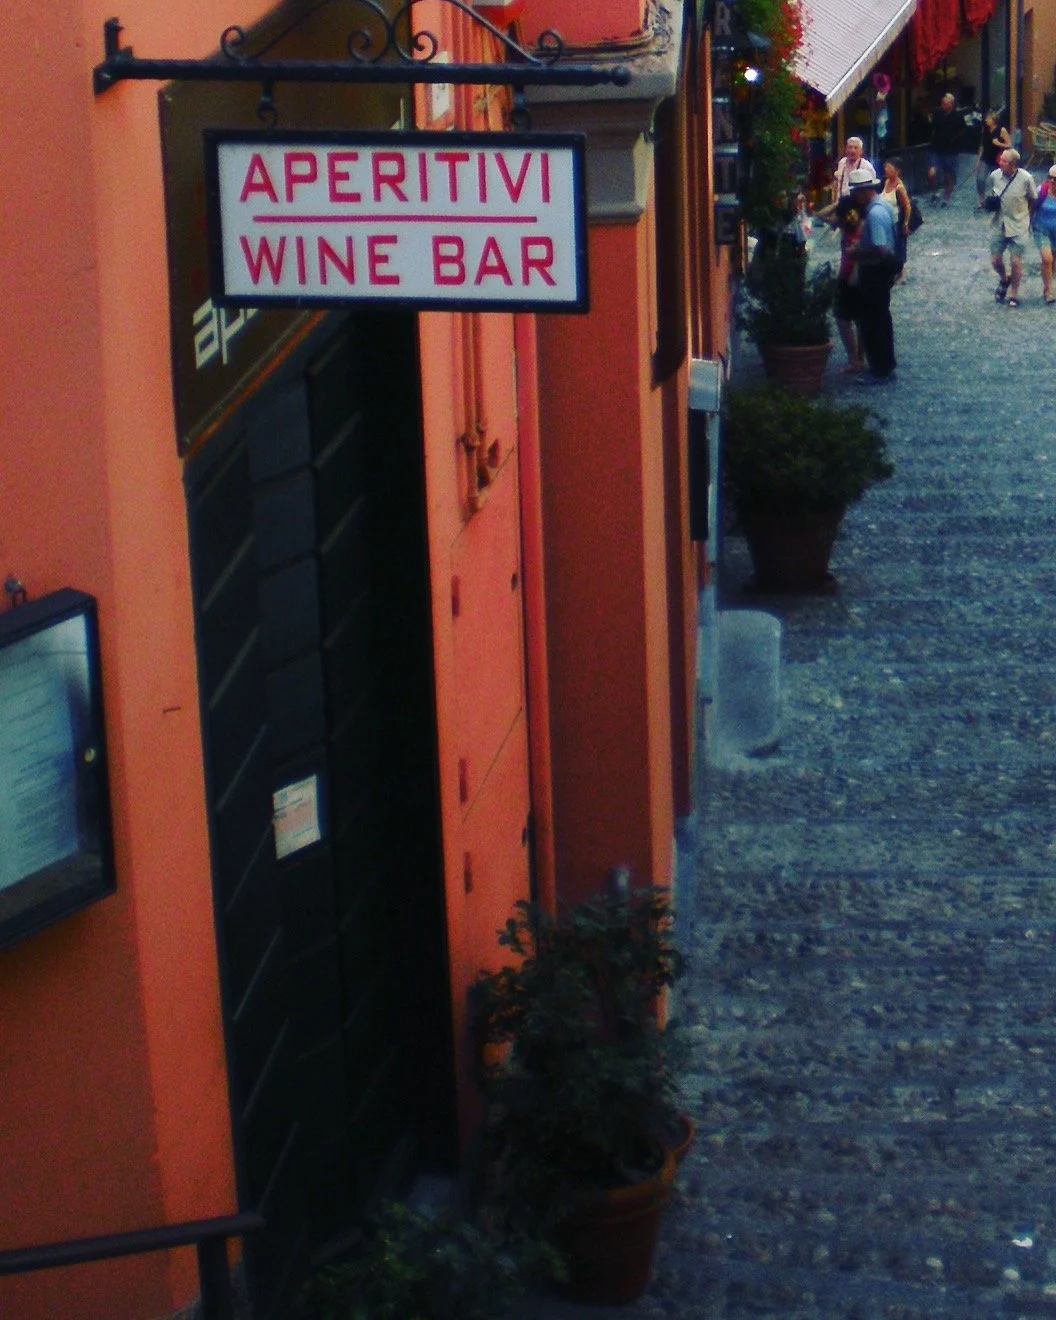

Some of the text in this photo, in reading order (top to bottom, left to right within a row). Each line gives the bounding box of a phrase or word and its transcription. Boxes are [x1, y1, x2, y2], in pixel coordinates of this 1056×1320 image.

[239, 151, 551, 204] APERITIVI
[239, 234, 557, 286] WINE BAR
